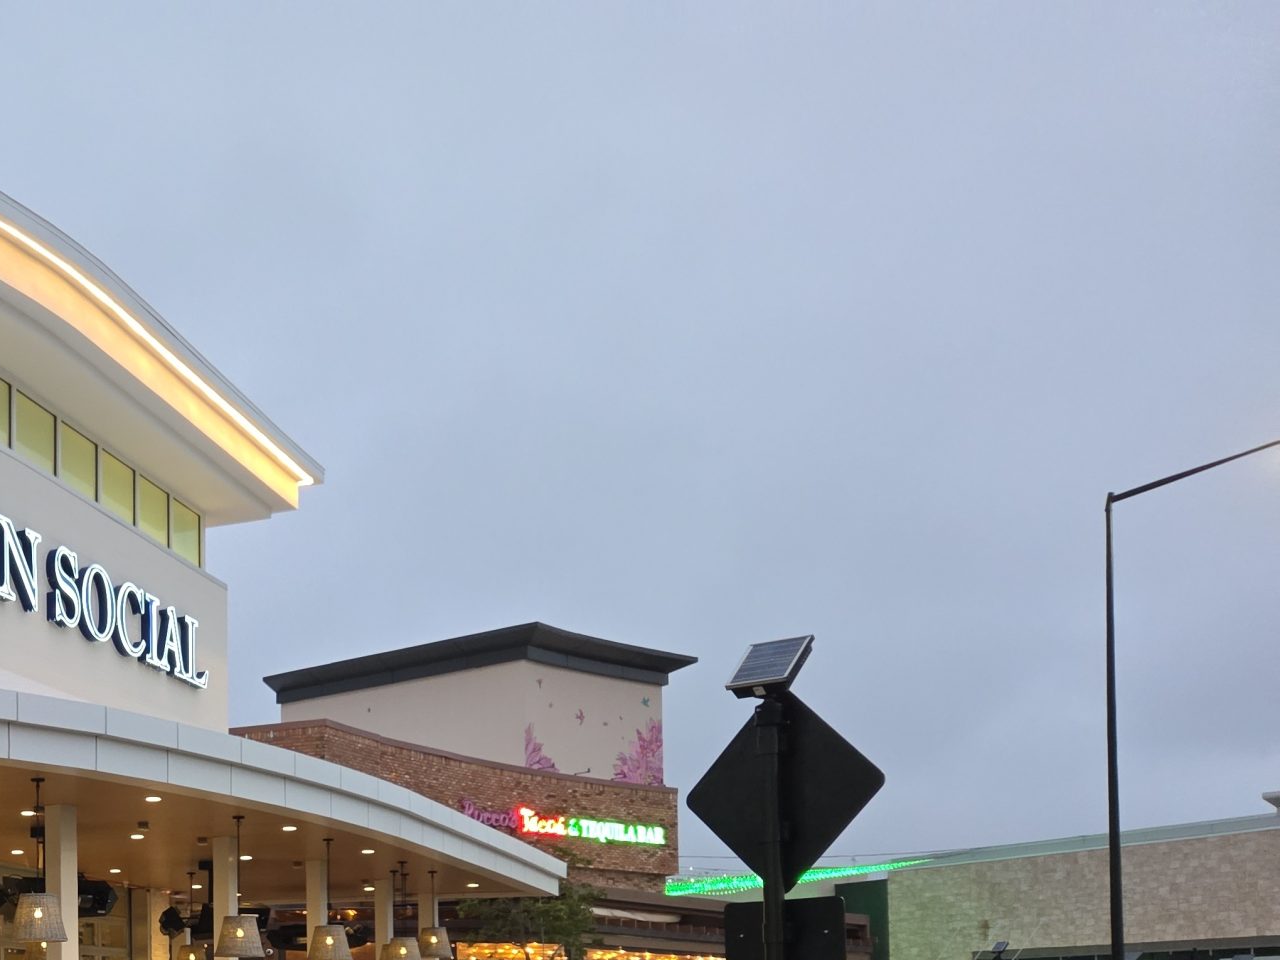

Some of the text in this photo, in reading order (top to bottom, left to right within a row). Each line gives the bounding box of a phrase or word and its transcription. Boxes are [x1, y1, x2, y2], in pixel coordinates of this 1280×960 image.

[46, 545, 209, 690] SOCIAL
[463, 800, 517, 828] Rocco's
[567, 819, 579, 837] &
[579, 819, 637, 843] TEQUILA
[637, 825, 665, 845] BAR
